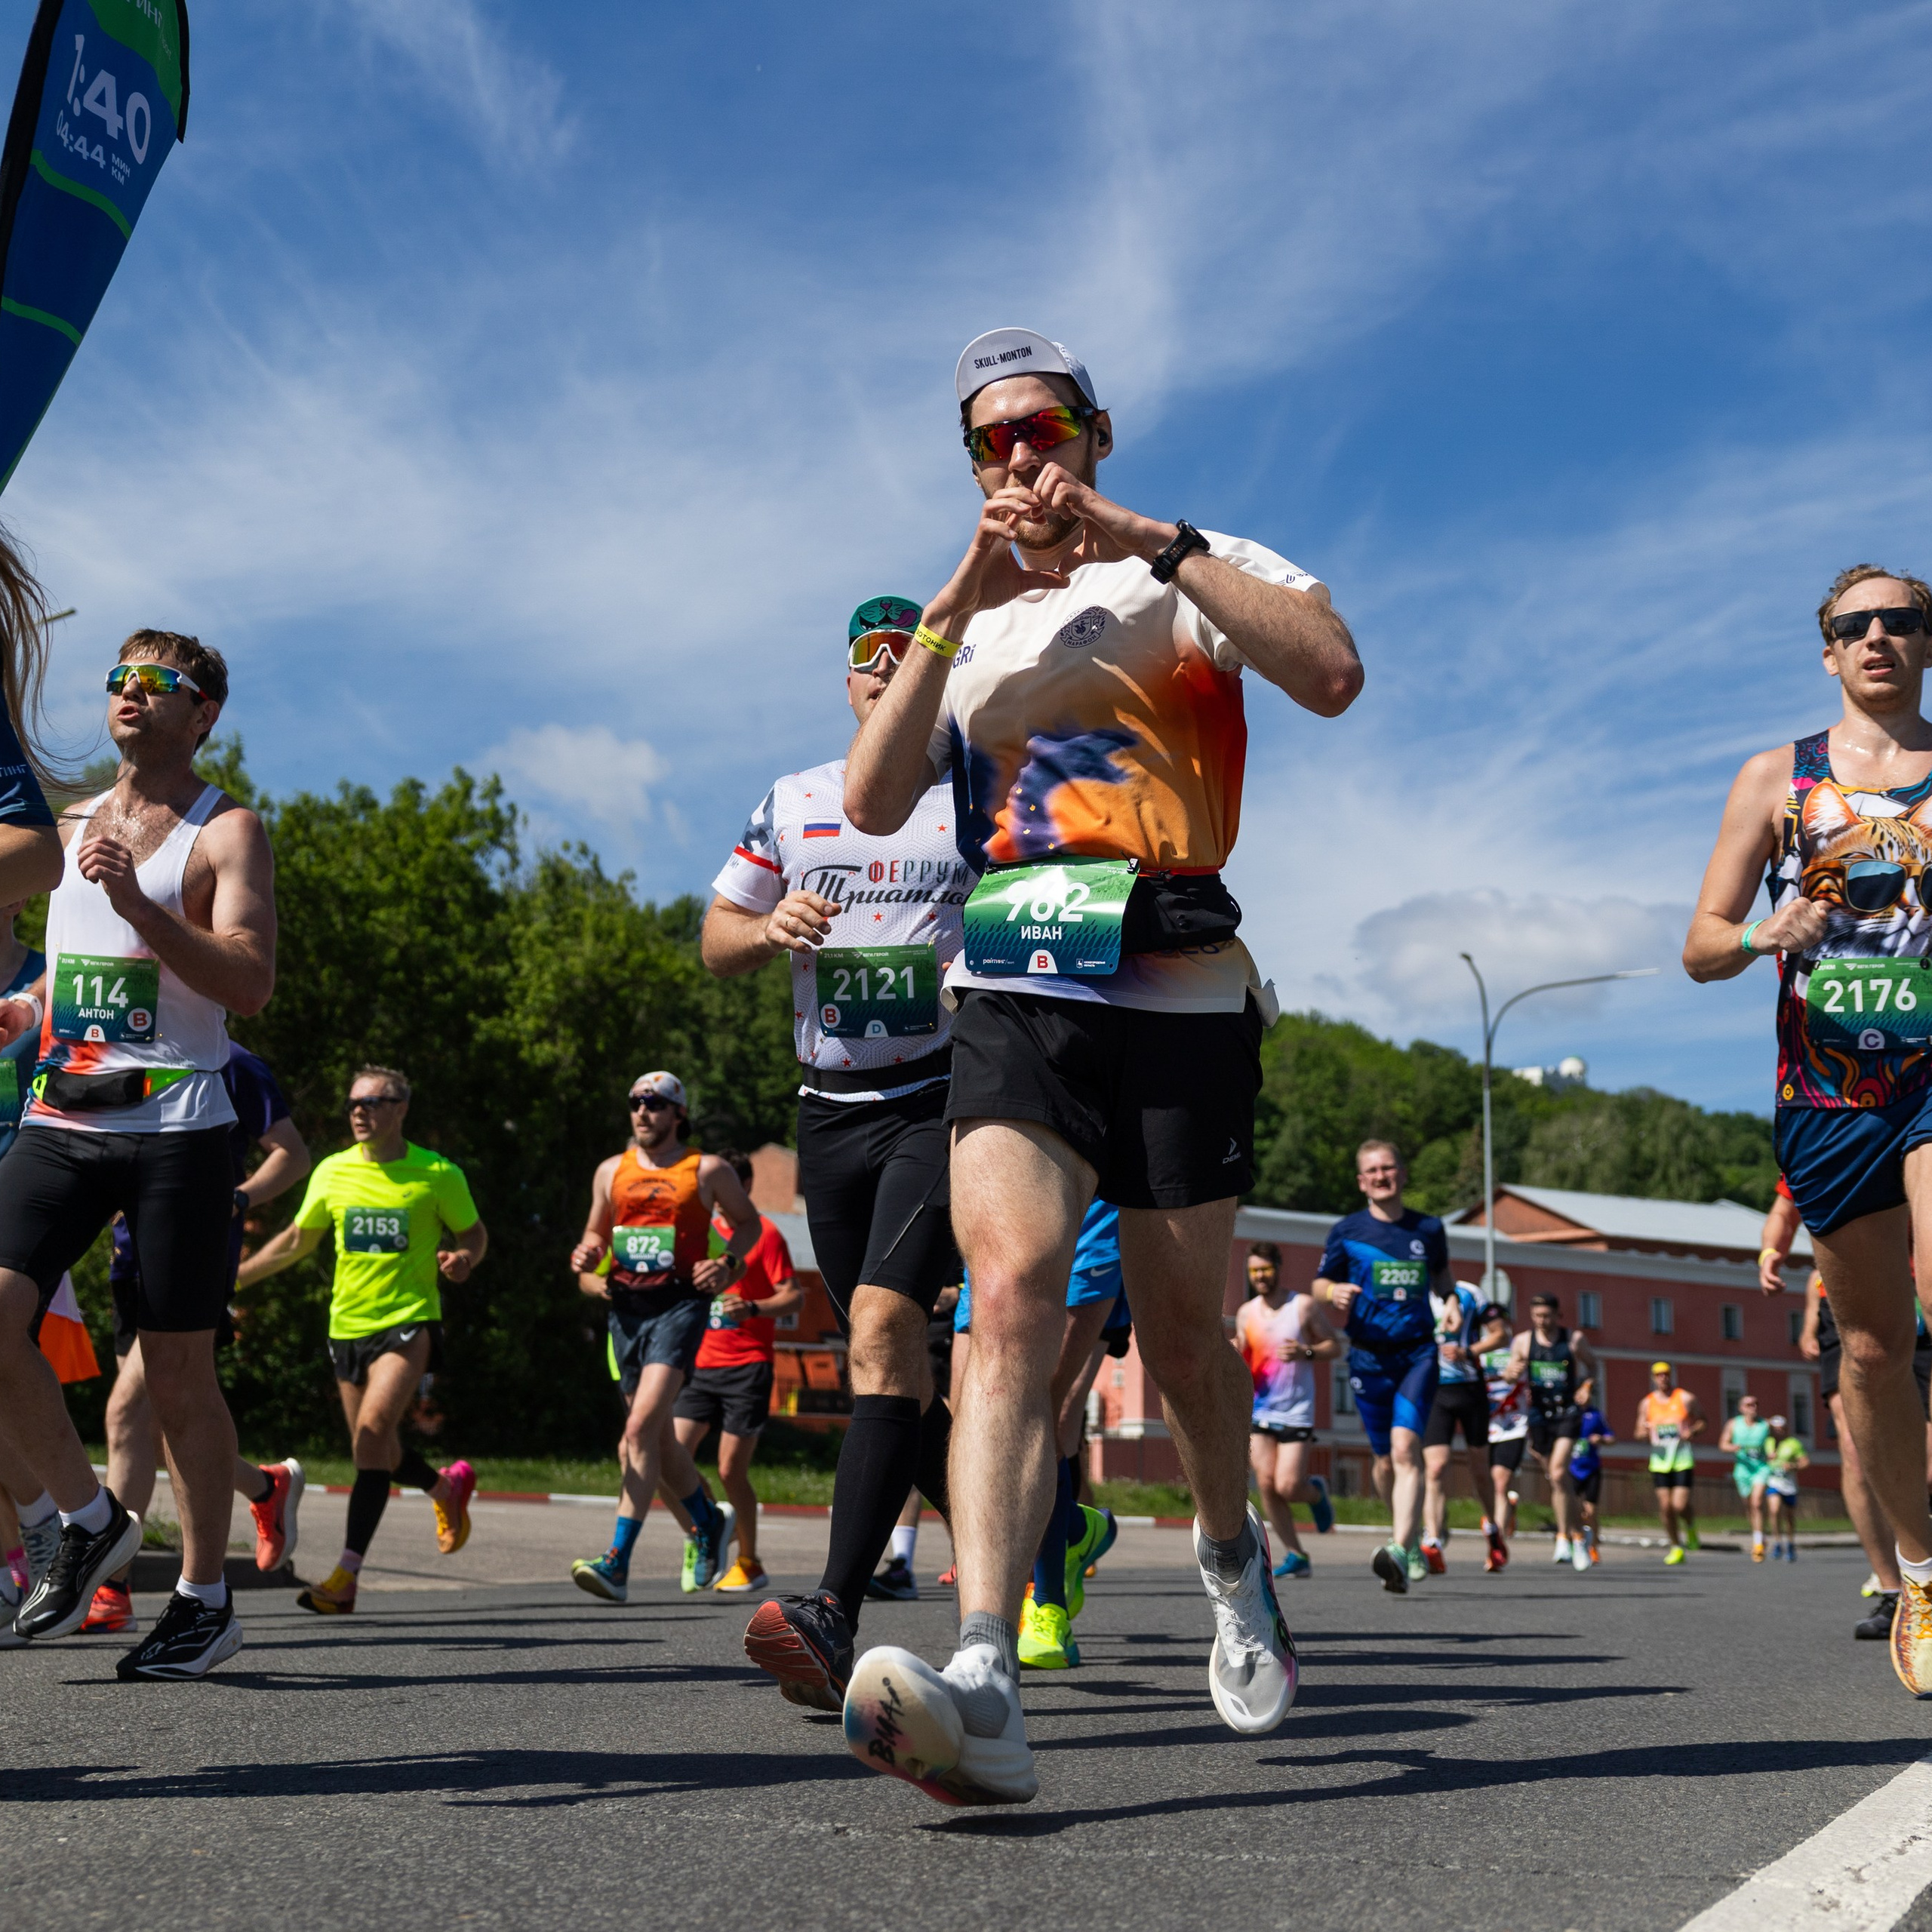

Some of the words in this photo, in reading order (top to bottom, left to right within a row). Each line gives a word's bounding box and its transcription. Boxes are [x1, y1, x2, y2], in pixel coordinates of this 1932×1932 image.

[126, 0, 162, 29] ИНГ
[66, 34, 151, 165] 1:40
[56, 109, 106, 169] 04:44
[111, 166, 125, 186] КМ
[112, 153, 131, 177] МИН
[869, 860, 969, 886] ФЕРРУМ
[801, 864, 972, 913] Триатло
[1020, 925, 1062, 940] ИВАН
[1037, 955, 1048, 968] B
[72, 974, 128, 1008] 114
[832, 966, 915, 1001] 2121
[1823, 978, 1917, 1012] 2176
[78, 1008, 115, 1020] АНТОН
[872, 1024, 881, 1034] D
[352, 1216, 400, 1235] 2153
[626, 1235, 660, 1254] 872
